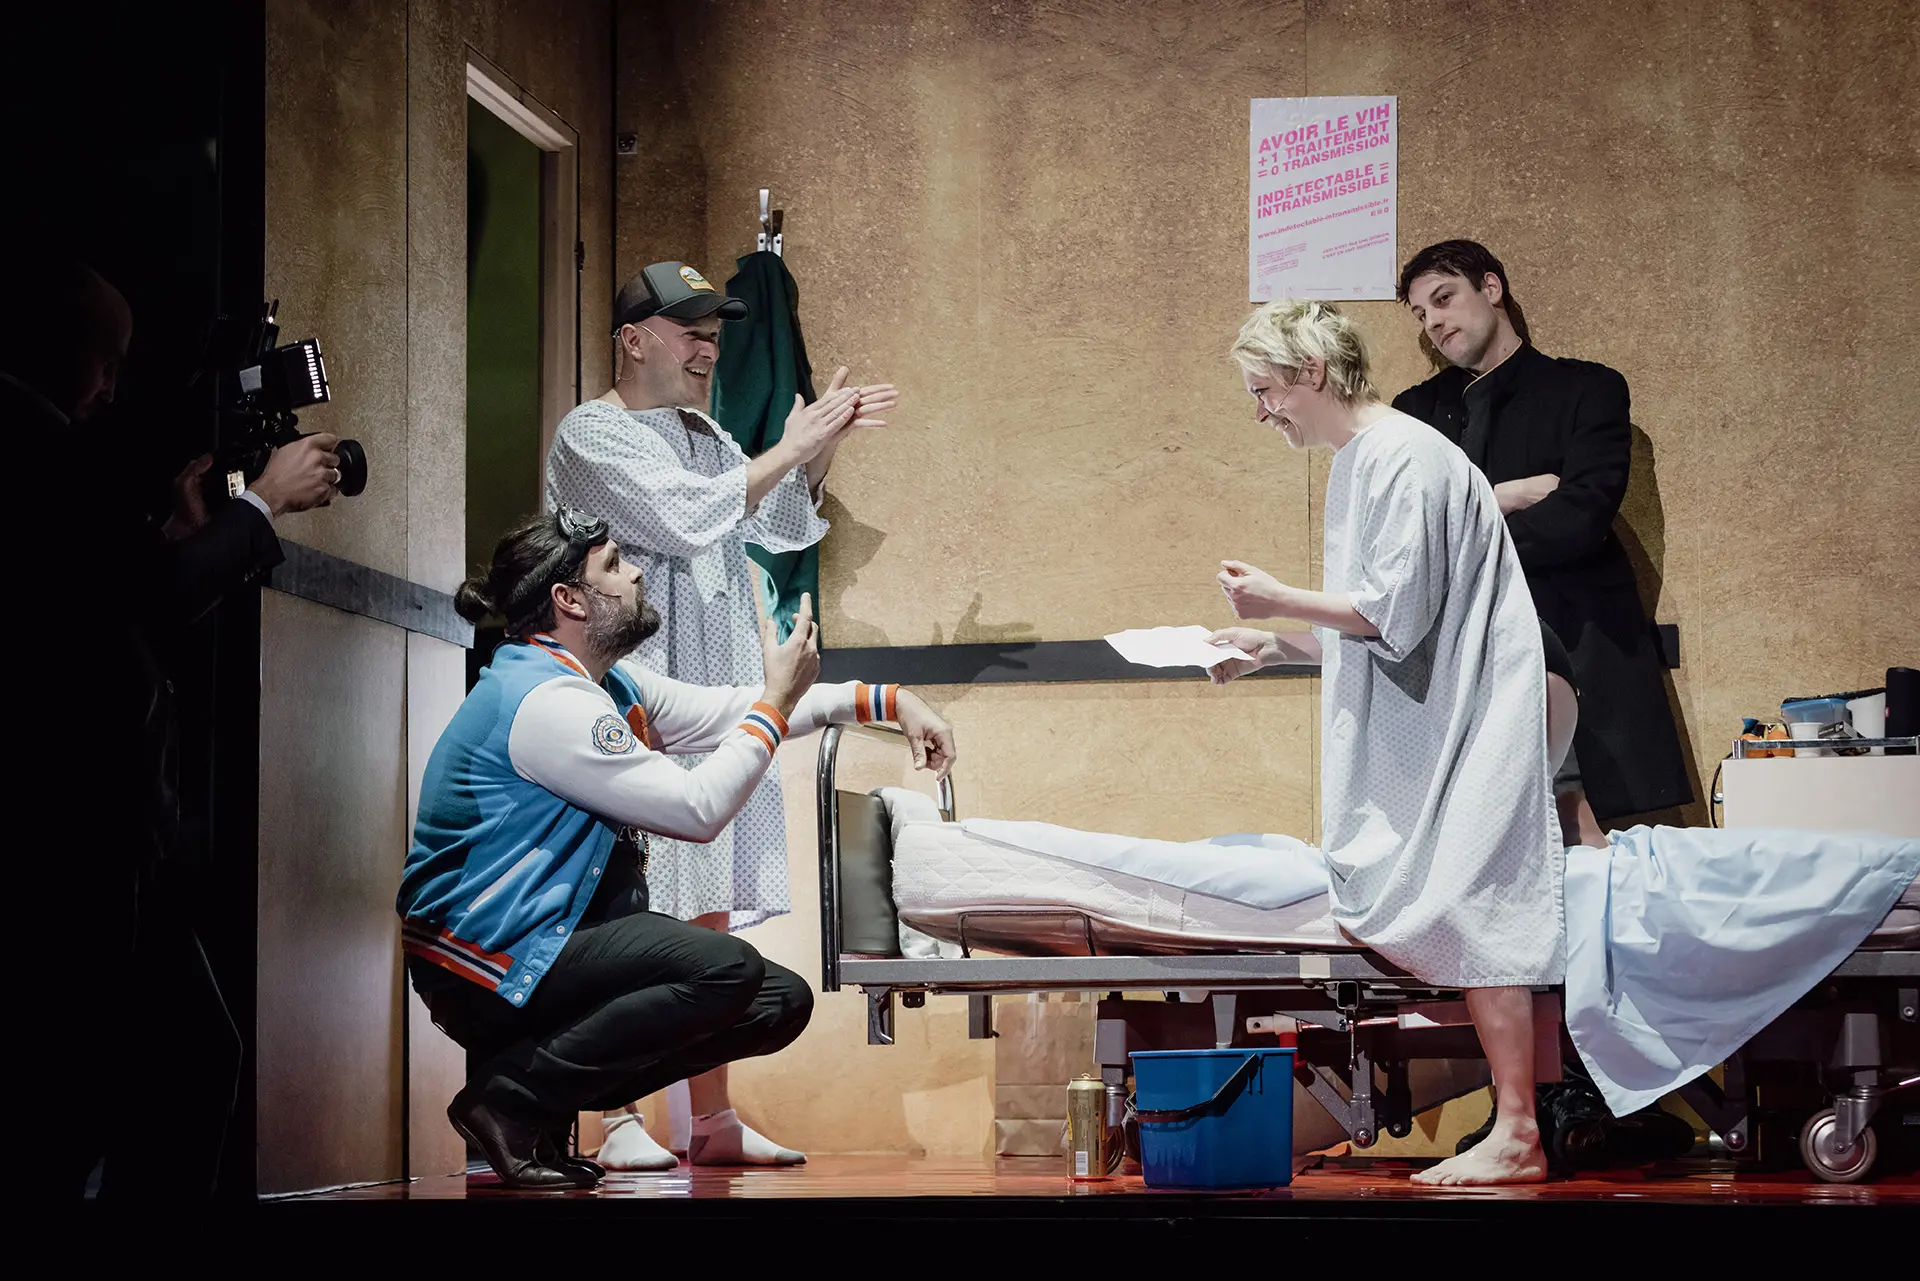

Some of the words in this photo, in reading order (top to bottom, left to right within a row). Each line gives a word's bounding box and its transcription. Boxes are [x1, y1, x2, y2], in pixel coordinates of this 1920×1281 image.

[1258, 124, 1319, 154] AVOIR
[1325, 115, 1349, 135] LE
[1355, 103, 1390, 125] VIH
[1271, 151, 1278, 163] 1
[1285, 119, 1389, 159] TRAITEMENT
[1282, 133, 1390, 172] TRANSMISSION
[1257, 163, 1374, 207] INDÉTECTABLE
[1257, 172, 1389, 219] INTRANSMISSIBLE
